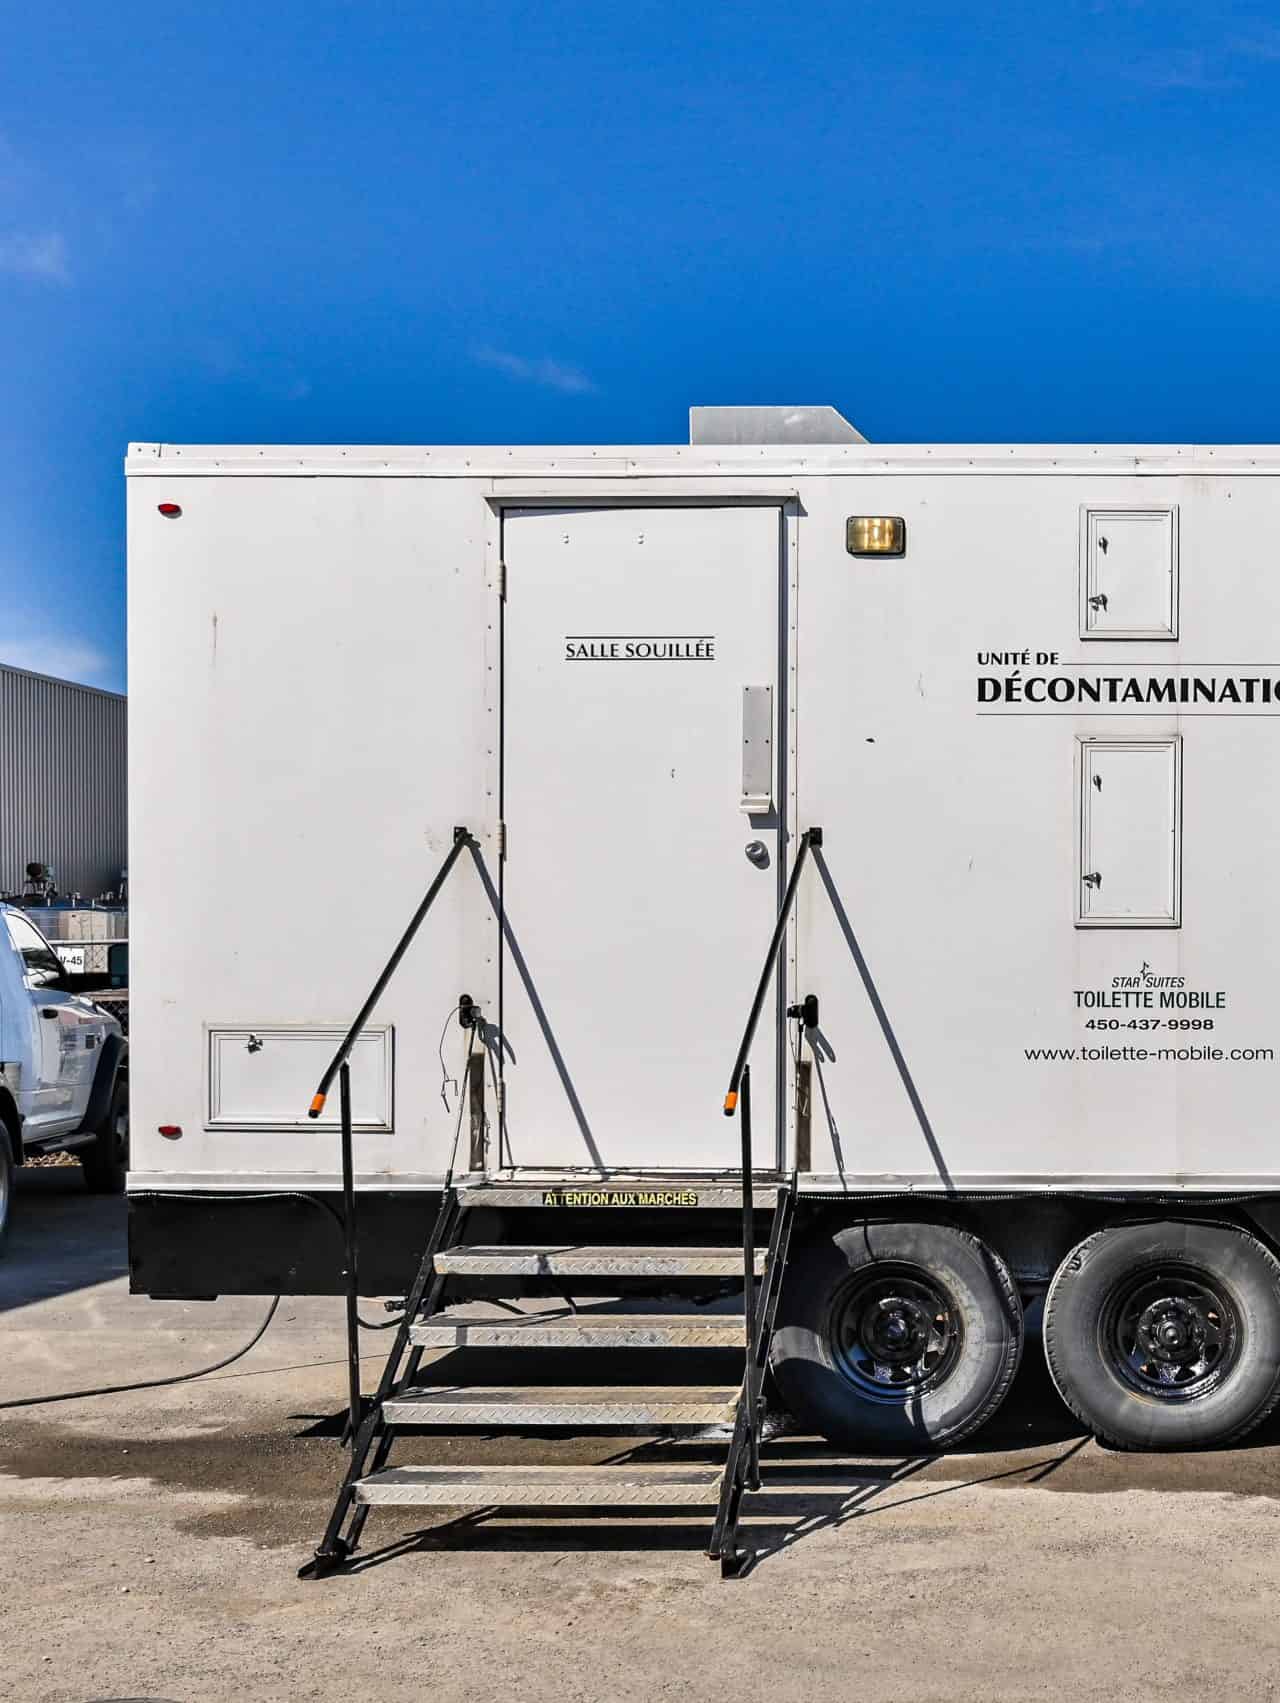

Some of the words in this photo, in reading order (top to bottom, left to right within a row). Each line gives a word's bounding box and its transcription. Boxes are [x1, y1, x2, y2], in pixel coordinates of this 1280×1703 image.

[566, 643, 619, 657] SALLE
[625, 640, 714, 657] SOUILLÉE
[977, 648, 1031, 666] UNITÉ
[1036, 652, 1060, 666] DE
[1111, 976, 1141, 988] STAR
[1145, 976, 1185, 988] SUITES
[1073, 990, 1154, 1009] TOILETTE
[1159, 991, 1226, 1009] MOBILE
[1085, 1018, 1214, 1031] 450-437-9998
[1024, 1045, 1274, 1061] www.toilette-mobile.com
[544, 1192, 609, 1205] ATTENTION
[611, 1192, 636, 1205] AUX
[638, 1192, 697, 1205] MARCHES
